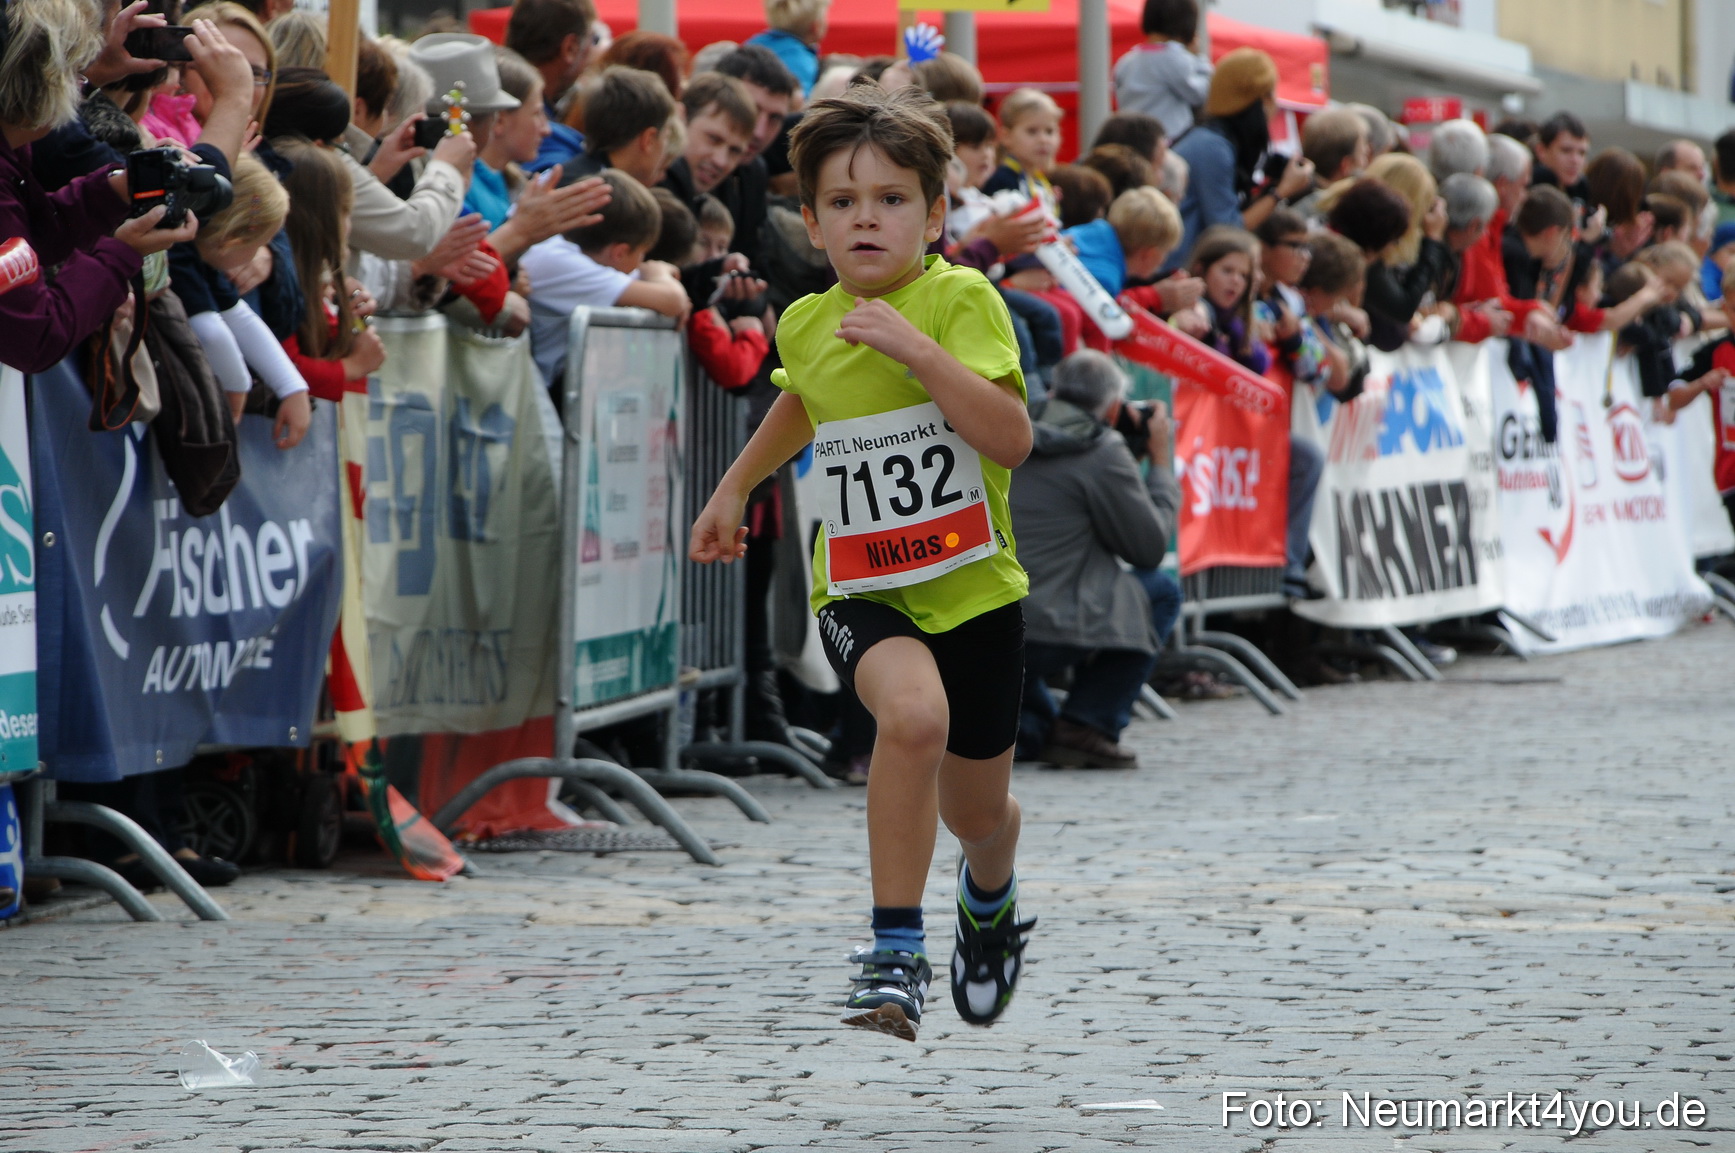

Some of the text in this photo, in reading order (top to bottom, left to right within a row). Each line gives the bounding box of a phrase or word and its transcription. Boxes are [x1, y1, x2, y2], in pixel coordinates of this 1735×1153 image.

[814, 439, 851, 458] PARTL
[852, 421, 938, 453] Neumarkt
[825, 444, 963, 526] 7132
[970, 489, 979, 501] M
[132, 498, 315, 618] Fischer
[865, 534, 943, 570] Niklas
